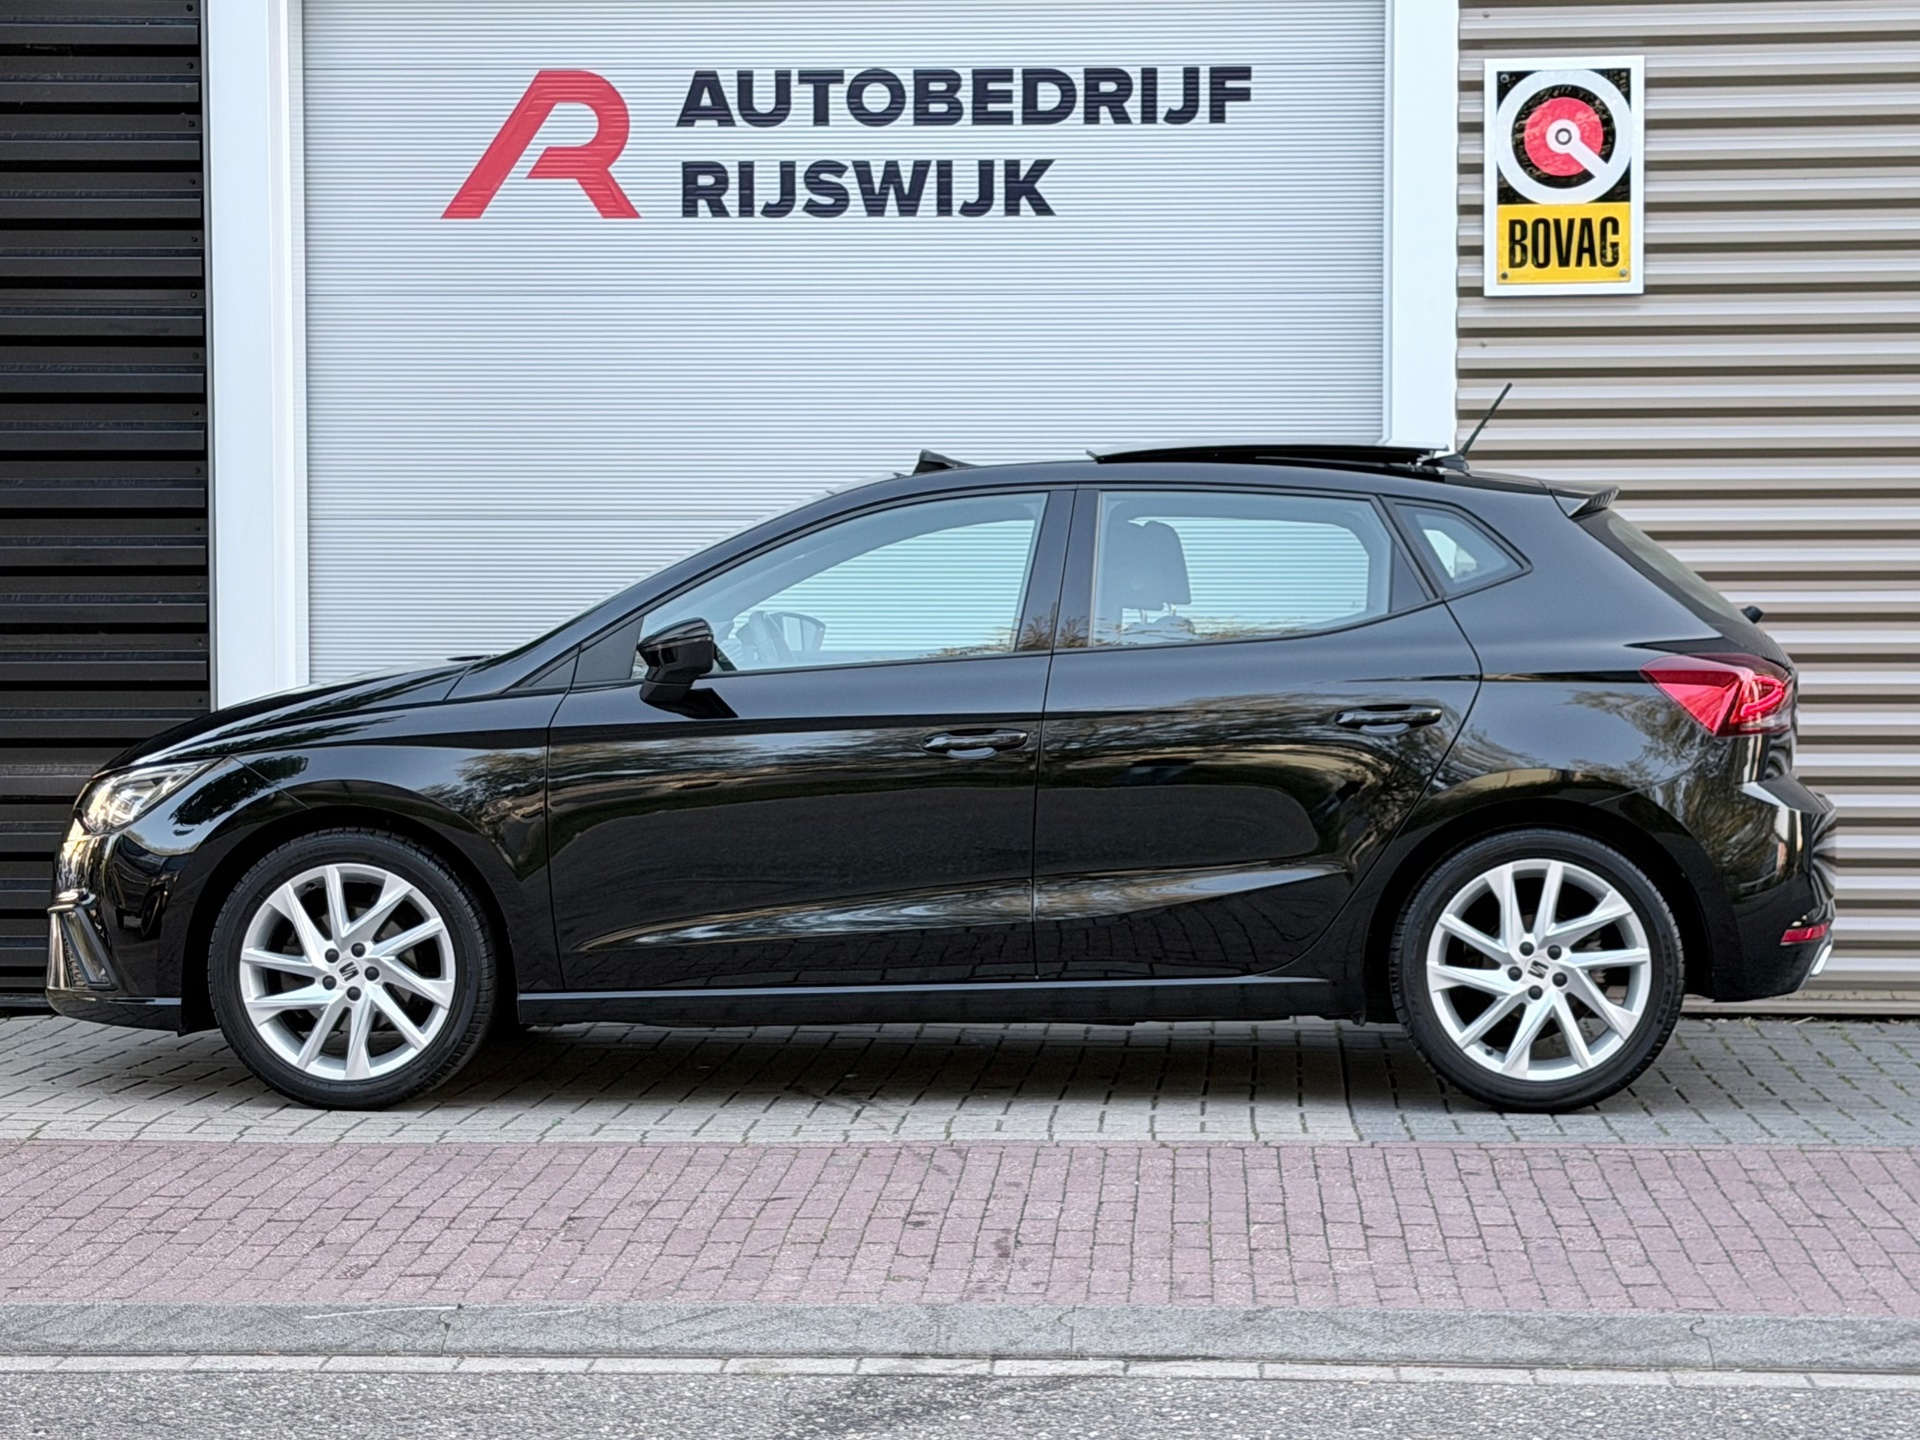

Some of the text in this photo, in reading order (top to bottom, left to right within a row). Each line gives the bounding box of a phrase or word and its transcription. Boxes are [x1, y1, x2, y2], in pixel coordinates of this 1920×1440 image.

[676, 66, 1252, 128] AUTOBEDRIJF
[681, 159, 1055, 218] RIJSWIJK
[1508, 216, 1620, 269] BOVAG
